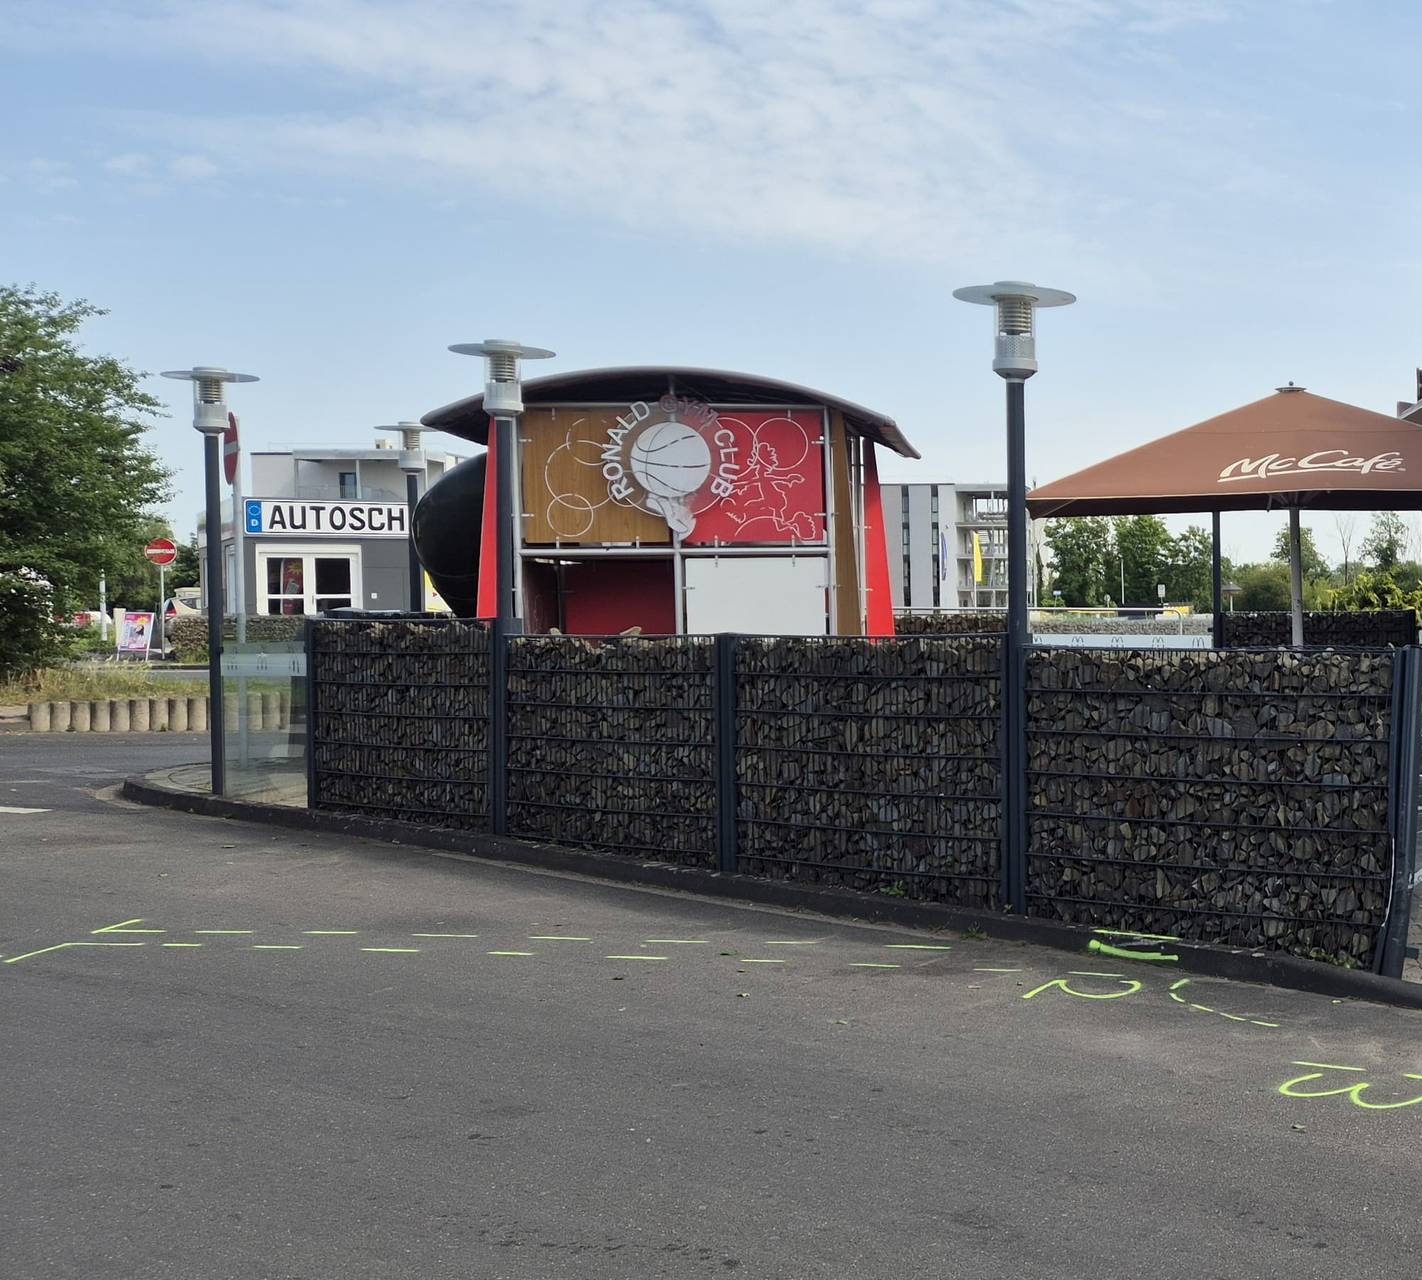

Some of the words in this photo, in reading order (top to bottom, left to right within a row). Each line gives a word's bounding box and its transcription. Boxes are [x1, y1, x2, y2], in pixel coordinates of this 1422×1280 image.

[601, 400, 650, 501] RONALD
[660, 394, 719, 427] GYM
[710, 429, 741, 498] CLUB
[268, 504, 405, 532] AUTOSCH
